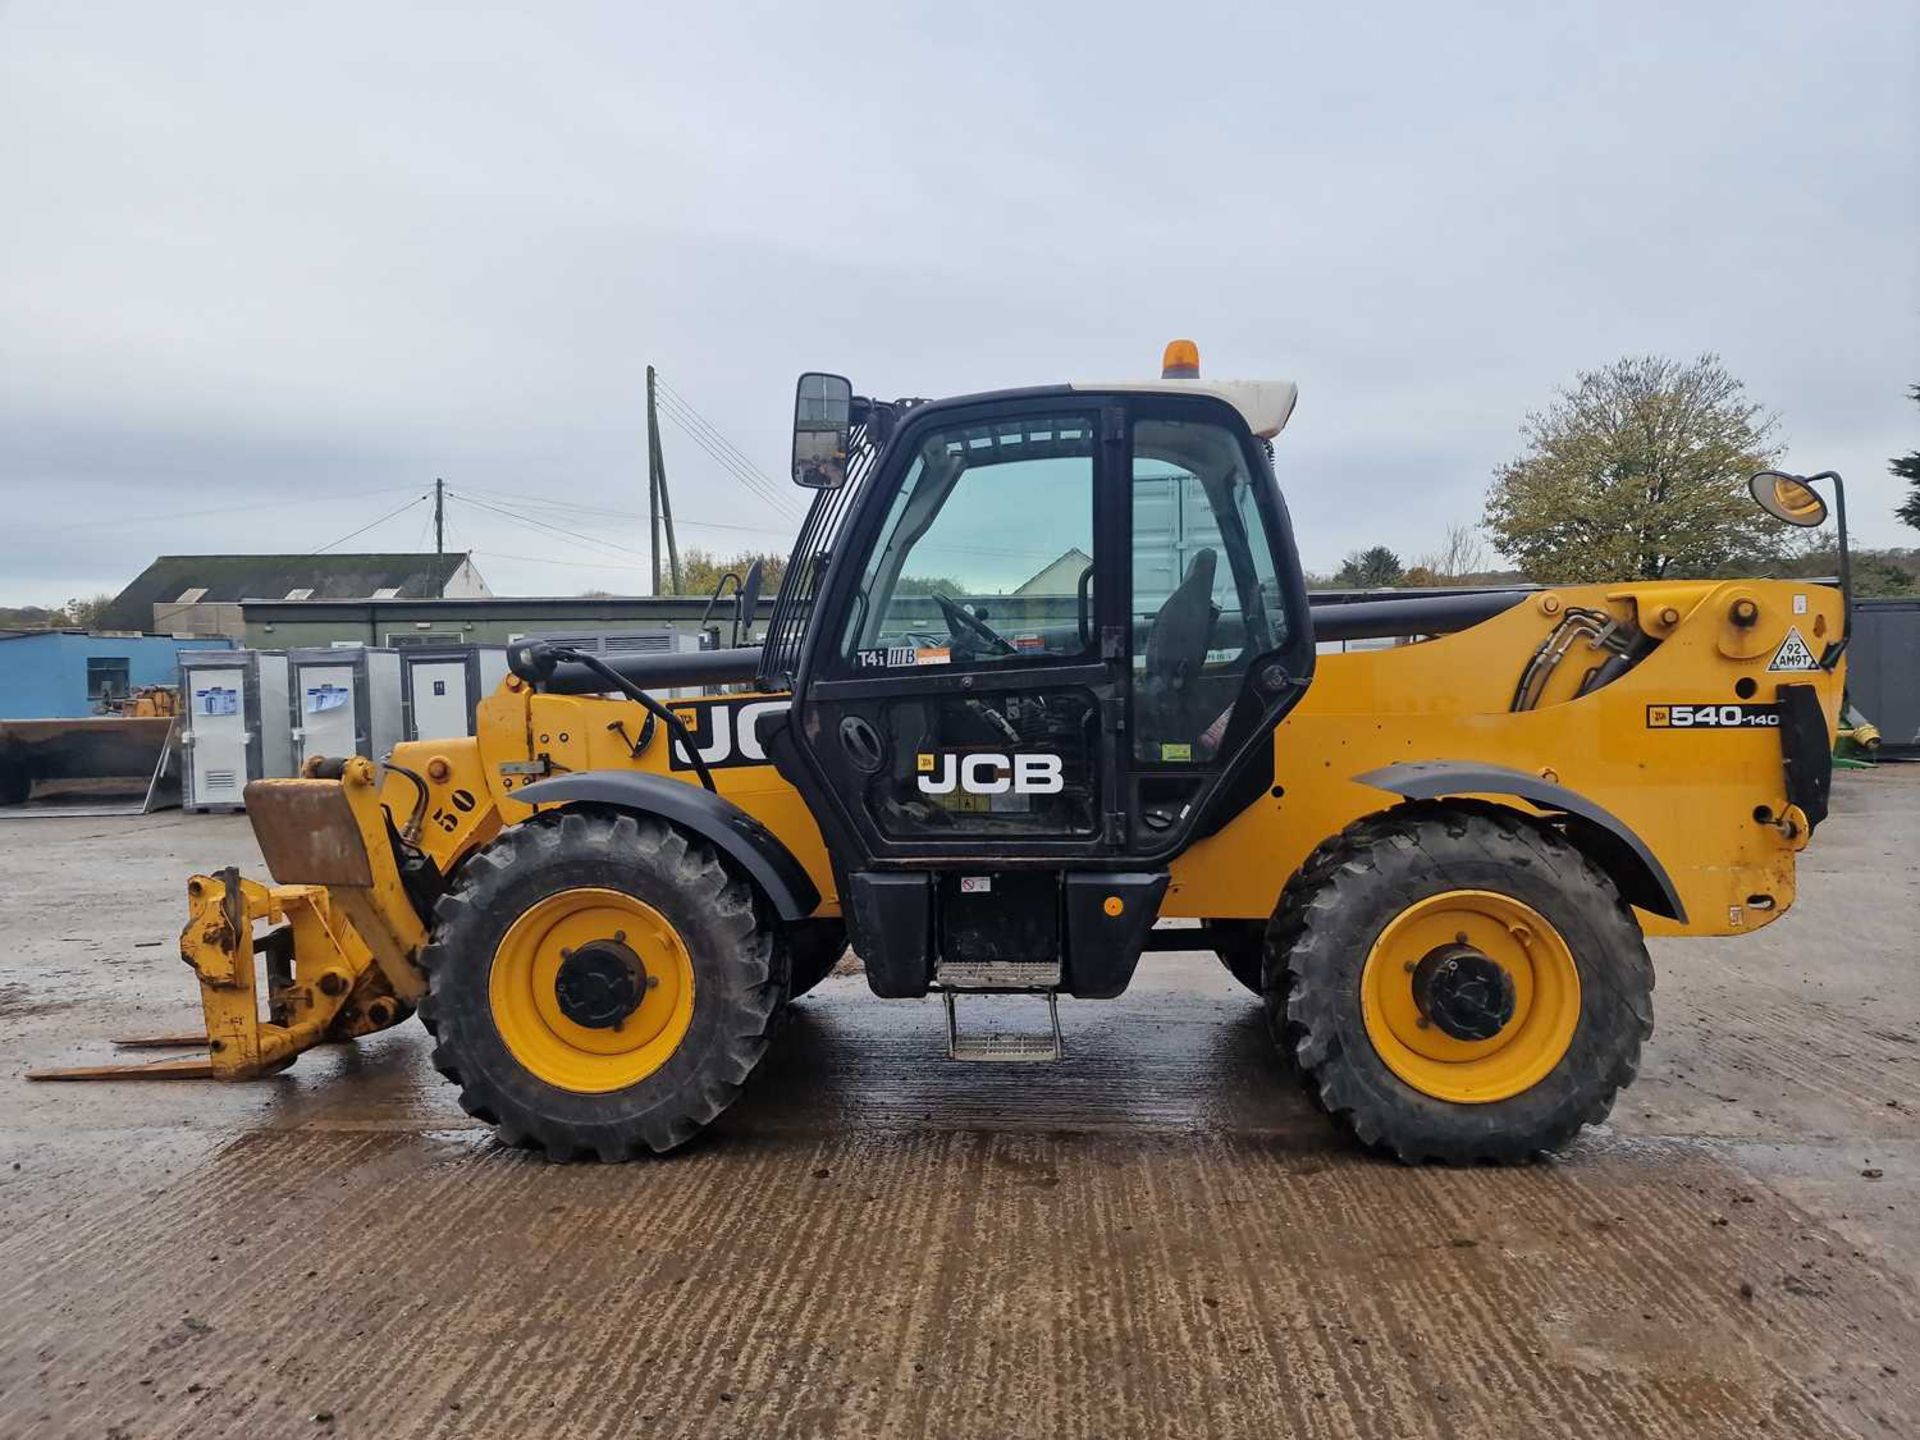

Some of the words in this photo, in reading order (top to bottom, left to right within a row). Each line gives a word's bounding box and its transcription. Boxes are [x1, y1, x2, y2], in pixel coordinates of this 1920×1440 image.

[857, 650, 885, 667] T4i
[1786, 643, 1801, 654] 92
[1779, 655, 1808, 666] AM9T
[1671, 706, 1779, 726] 540-140
[674, 701, 792, 763] JC
[917, 753, 1065, 794] JCB
[432, 789, 476, 833] 50
